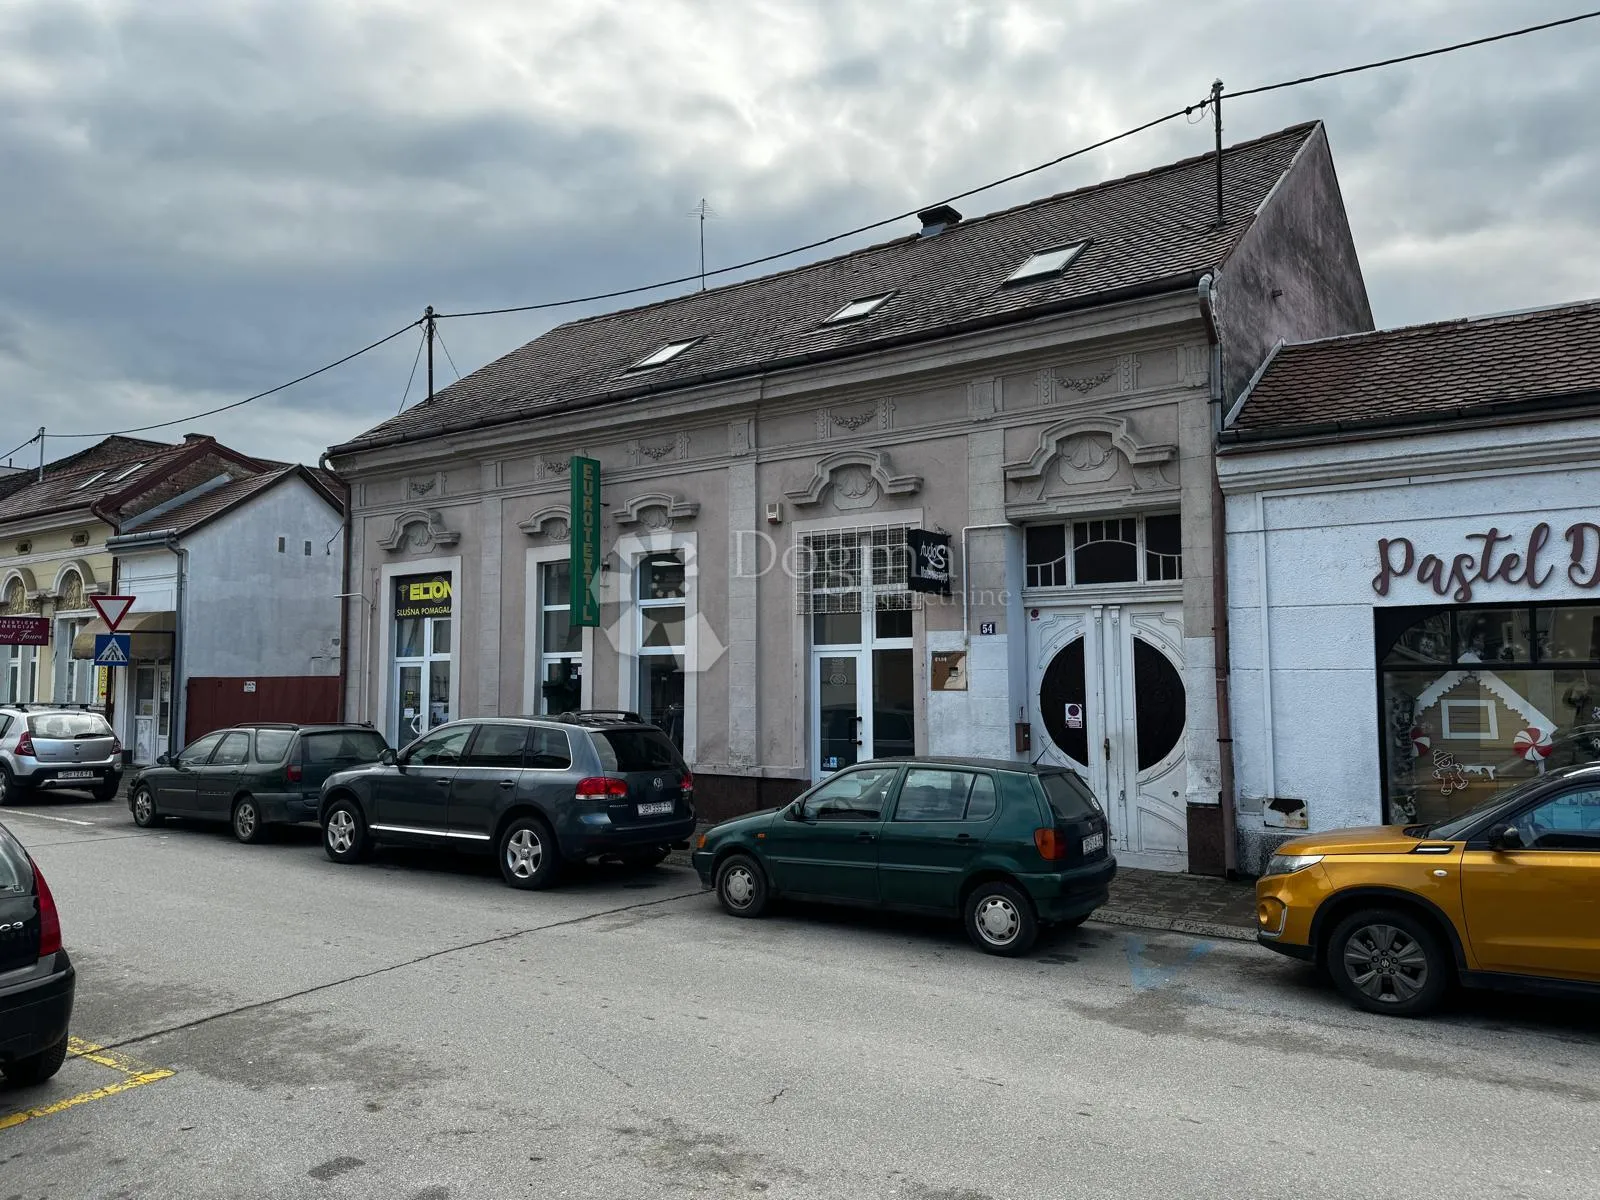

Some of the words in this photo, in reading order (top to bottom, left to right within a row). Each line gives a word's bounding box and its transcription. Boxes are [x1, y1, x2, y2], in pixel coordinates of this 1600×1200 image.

[582, 464, 594, 621] EUROTEXTIL
[1372, 522, 1554, 602] Pastel
[409, 581, 453, 601] ELTON
[396, 606, 420, 617] SLUŠNA
[982, 623, 993, 634] 54
